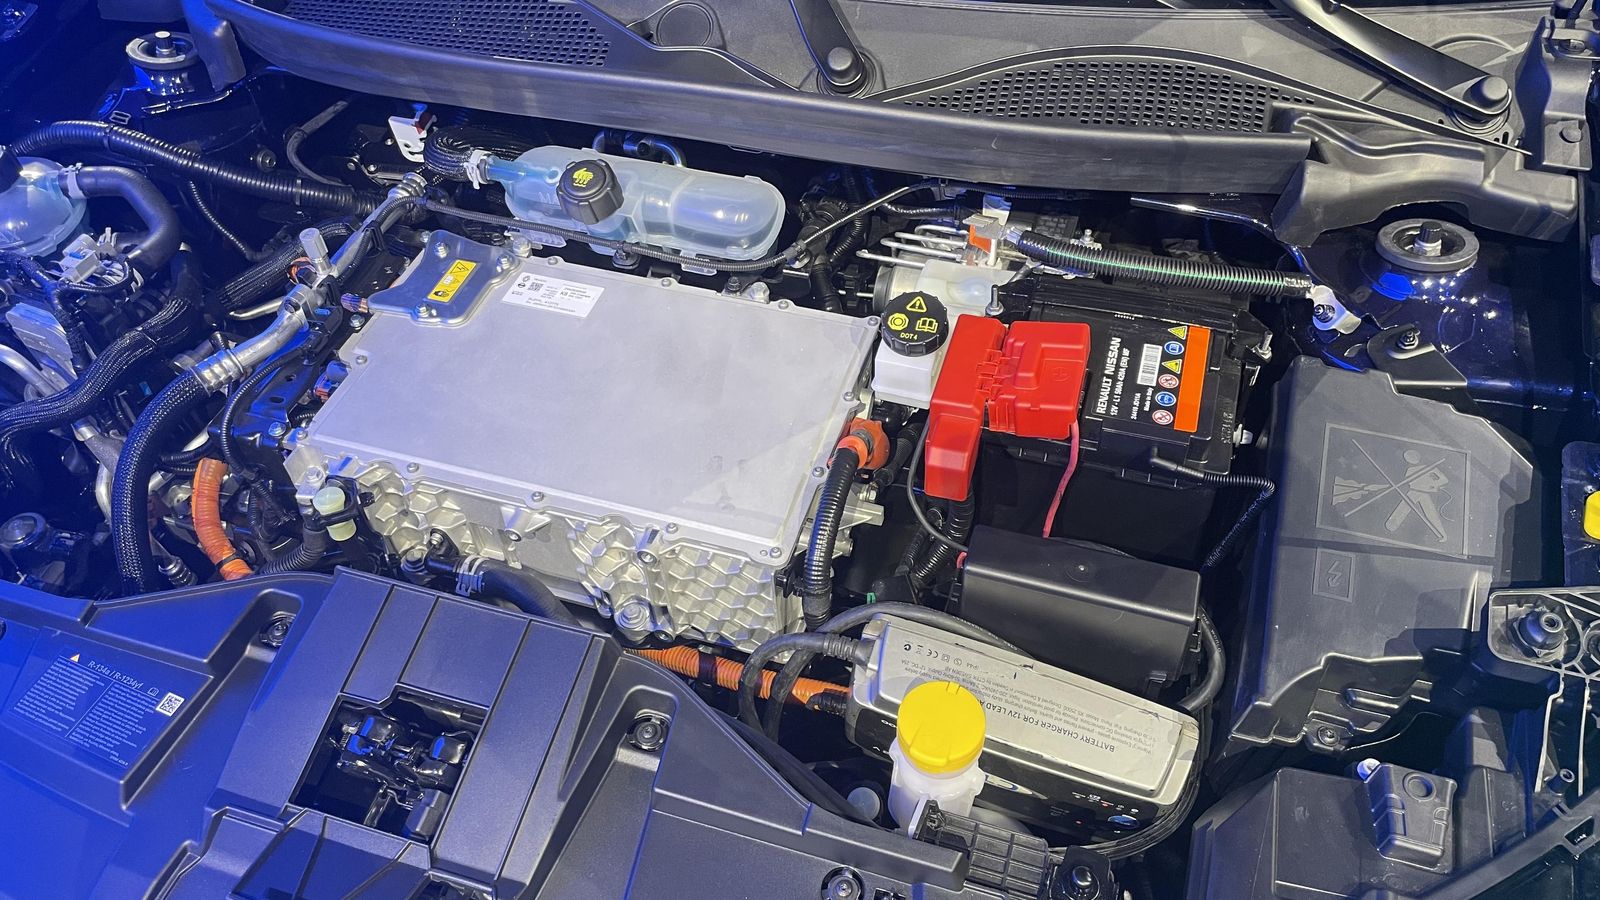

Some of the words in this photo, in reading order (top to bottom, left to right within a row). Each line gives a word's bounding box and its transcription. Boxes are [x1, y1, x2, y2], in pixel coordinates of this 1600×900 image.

[1096, 377, 1112, 413] RENAULT
[1104, 337, 1121, 374] NISSAN
[1115, 380, 1123, 395] 50Ah
[1146, 387, 1154, 395] Italy
[88, 661, 110, 674] R-134a
[113, 673, 143, 689] R-1234yf
[986, 703, 1006, 714] LEAD
[1007, 709, 1020, 719] 12V
[1023, 715, 1039, 725] FOR
[1041, 722, 1078, 739] CHARGER
[1079, 735, 1115, 752] BATTERY
